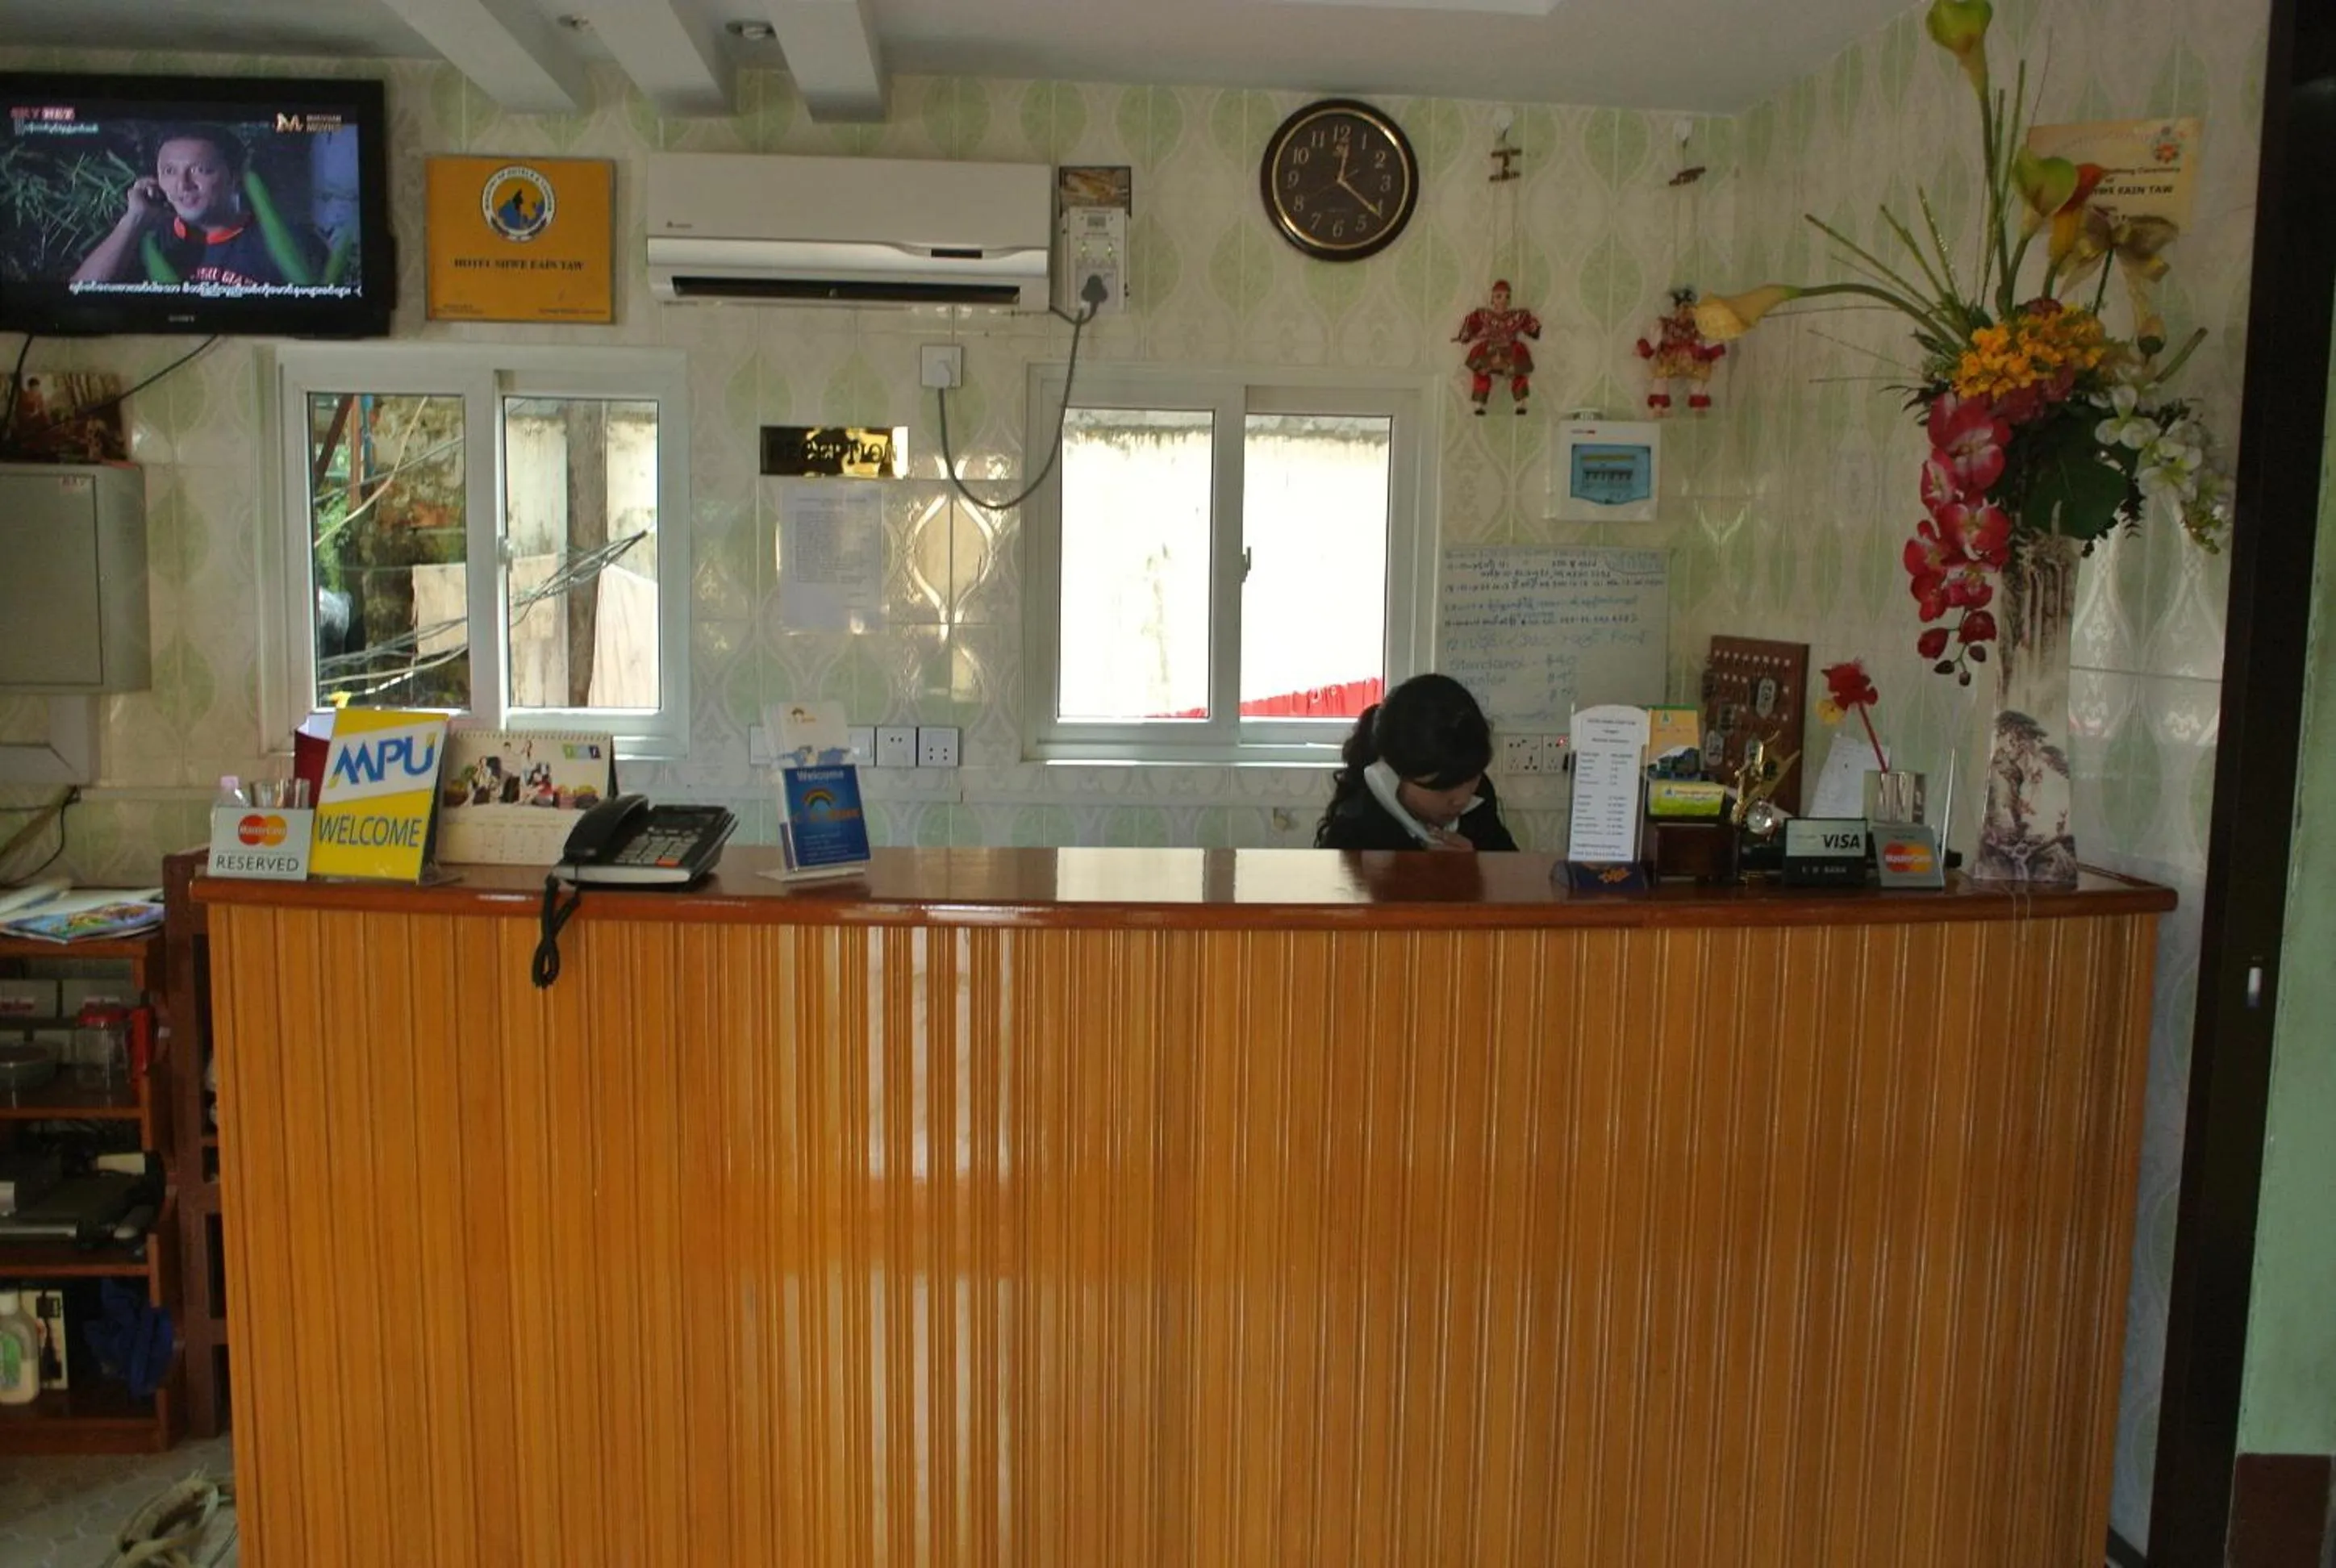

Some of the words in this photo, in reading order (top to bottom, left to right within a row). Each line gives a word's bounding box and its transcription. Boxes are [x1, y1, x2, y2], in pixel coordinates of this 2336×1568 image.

[1311, 130, 1325, 148] 11
[1333, 125, 1351, 144] 12
[1361, 133, 1367, 150] 1
[1293, 148, 1309, 165] 10
[1374, 151, 1387, 169] 2
[1287, 171, 1299, 189] 9
[1380, 174, 1391, 192] 3
[1294, 196, 1304, 212] 8
[1310, 212, 1321, 231] 7
[1333, 219, 1345, 237] 6
[1355, 213, 1367, 231] 5
[327, 732, 436, 789] MPU
[318, 812, 423, 848] WELCOME
[1821, 833, 1860, 850] VISA
[215, 855, 299, 873] RESERVED
